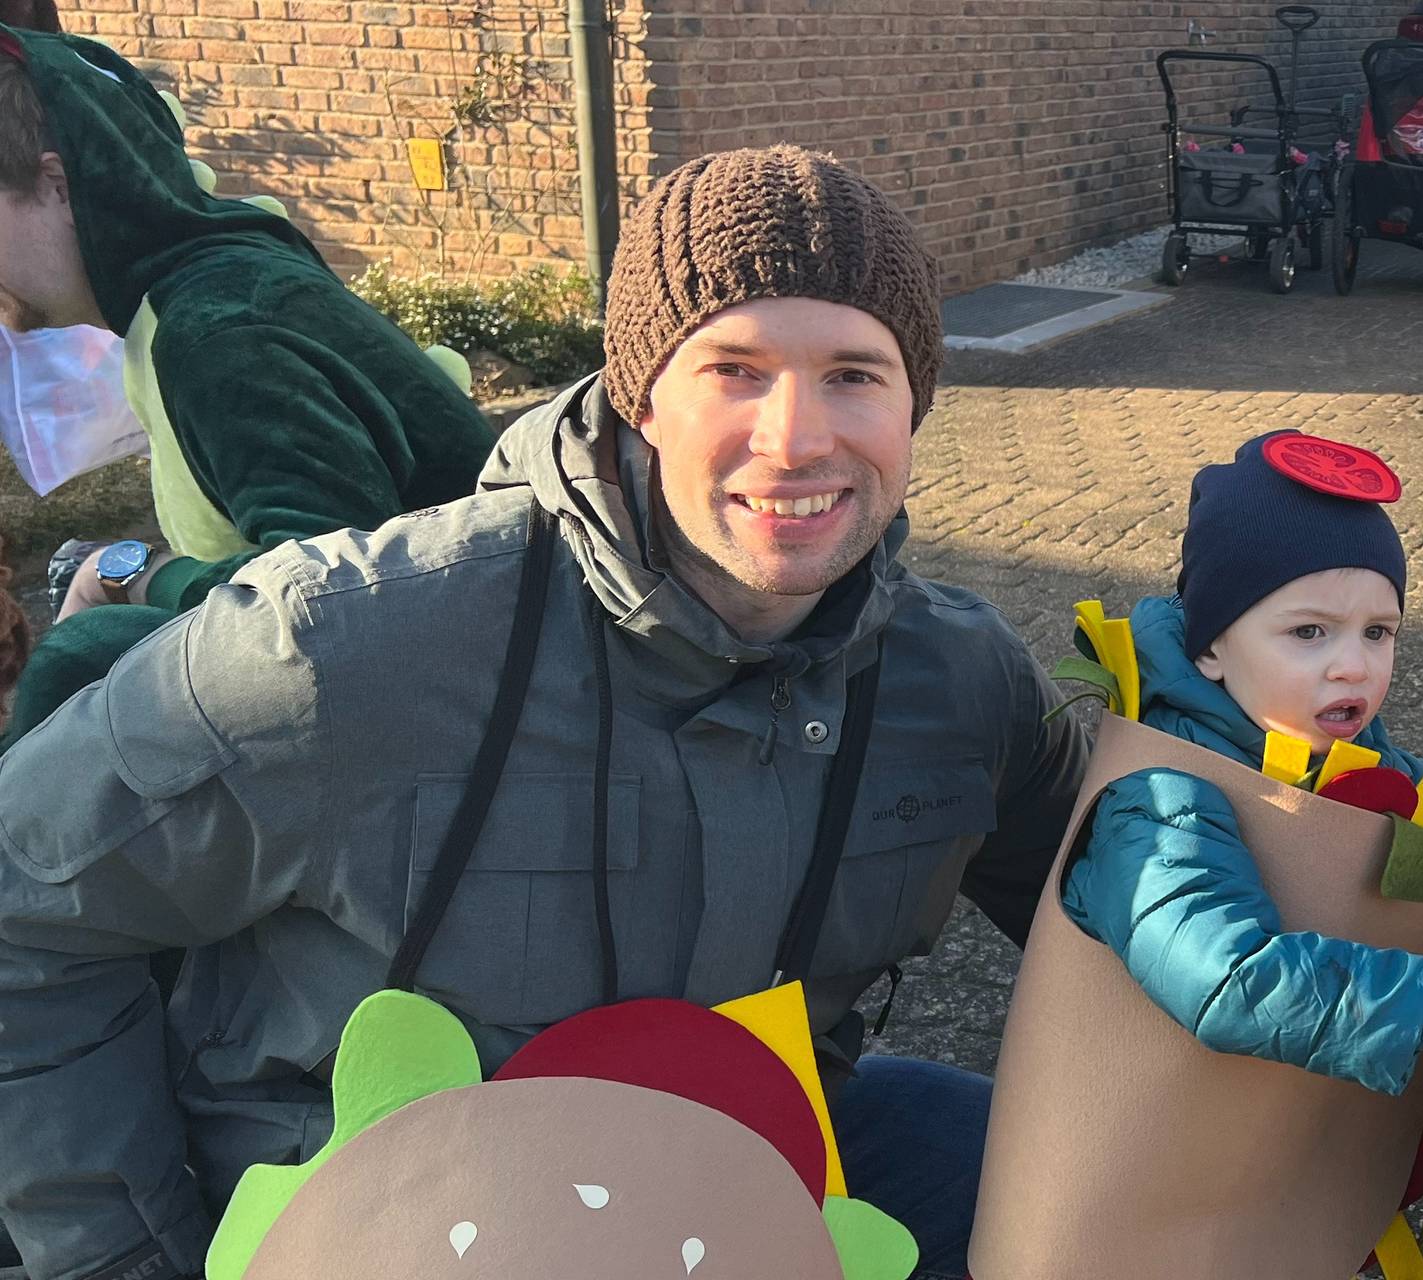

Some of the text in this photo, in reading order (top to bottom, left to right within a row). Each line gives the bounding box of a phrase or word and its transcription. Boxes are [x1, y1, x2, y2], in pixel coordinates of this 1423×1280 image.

[872, 795, 963, 821] OUR PLANET
[112, 1252, 165, 1280] NET
